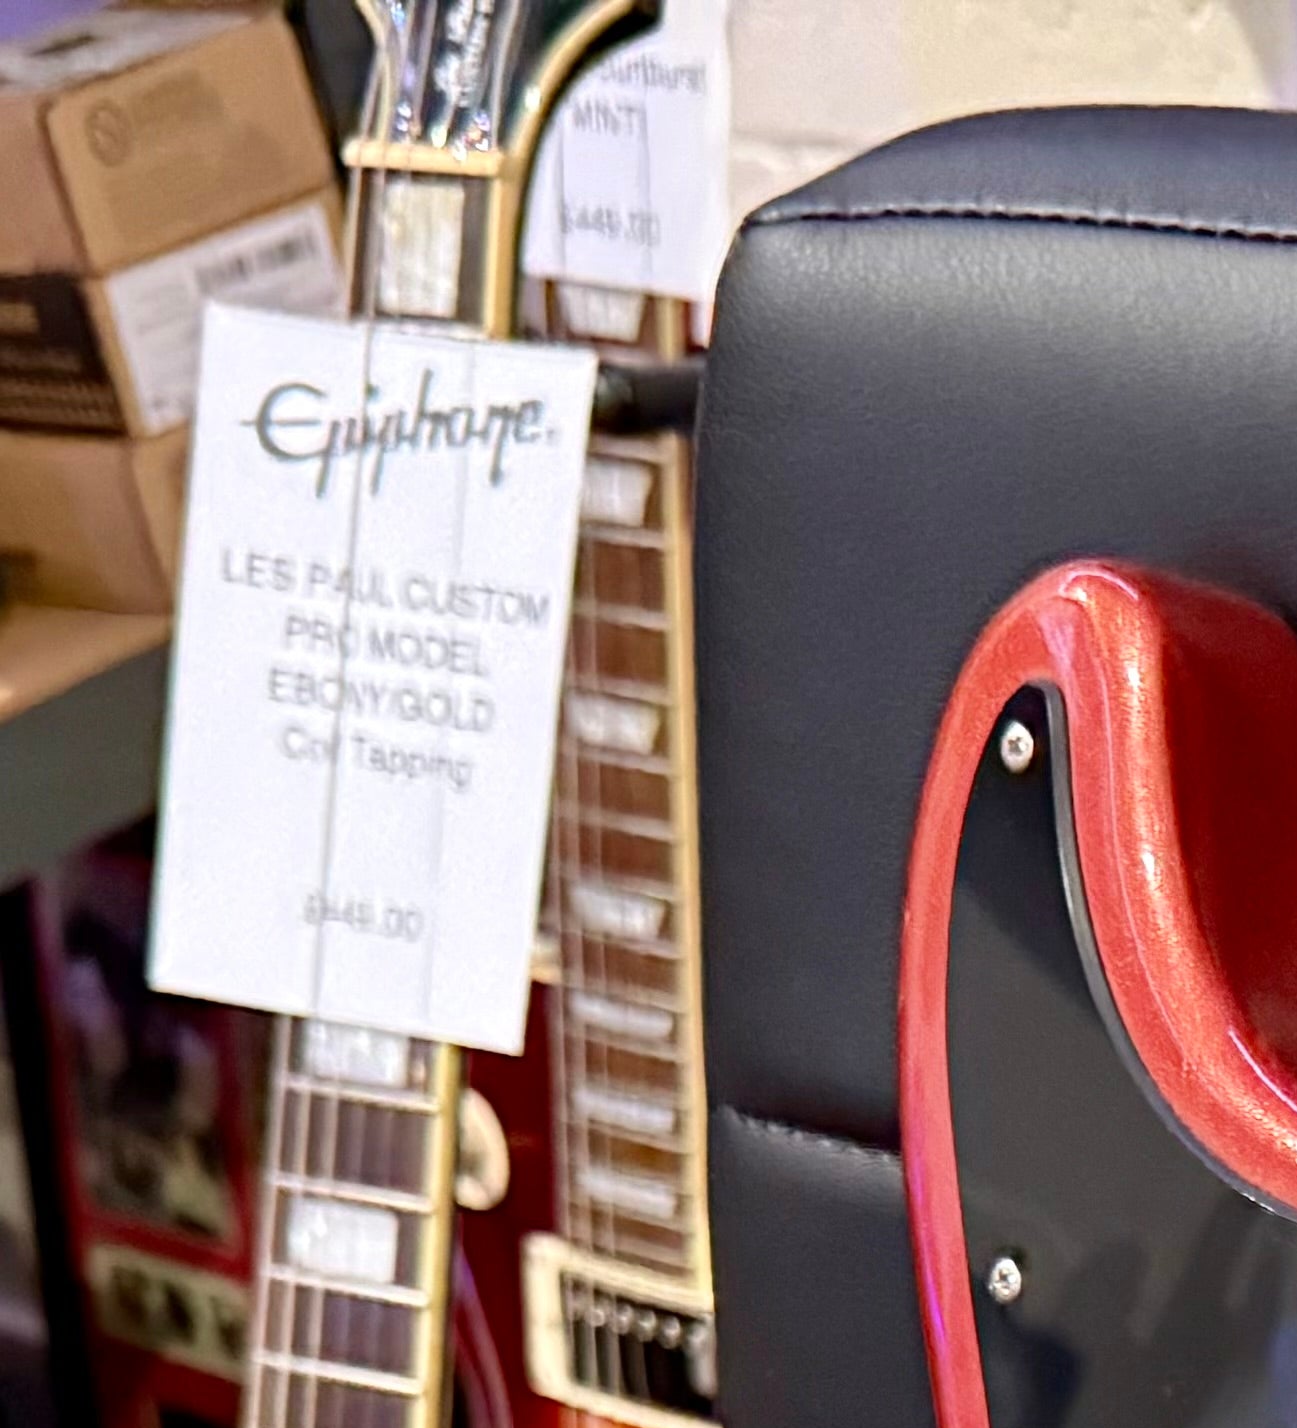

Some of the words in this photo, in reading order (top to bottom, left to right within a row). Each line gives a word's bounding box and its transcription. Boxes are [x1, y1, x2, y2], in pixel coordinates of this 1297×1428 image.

[239, 368, 547, 499] Epiphone
[221, 549, 297, 592] LES
[309, 562, 394, 608] PAUL
[402, 576, 550, 626] CUSTOM
[284, 614, 361, 659] PRO
[367, 627, 488, 677] MODEL
[351, 732, 475, 793] Tapping
